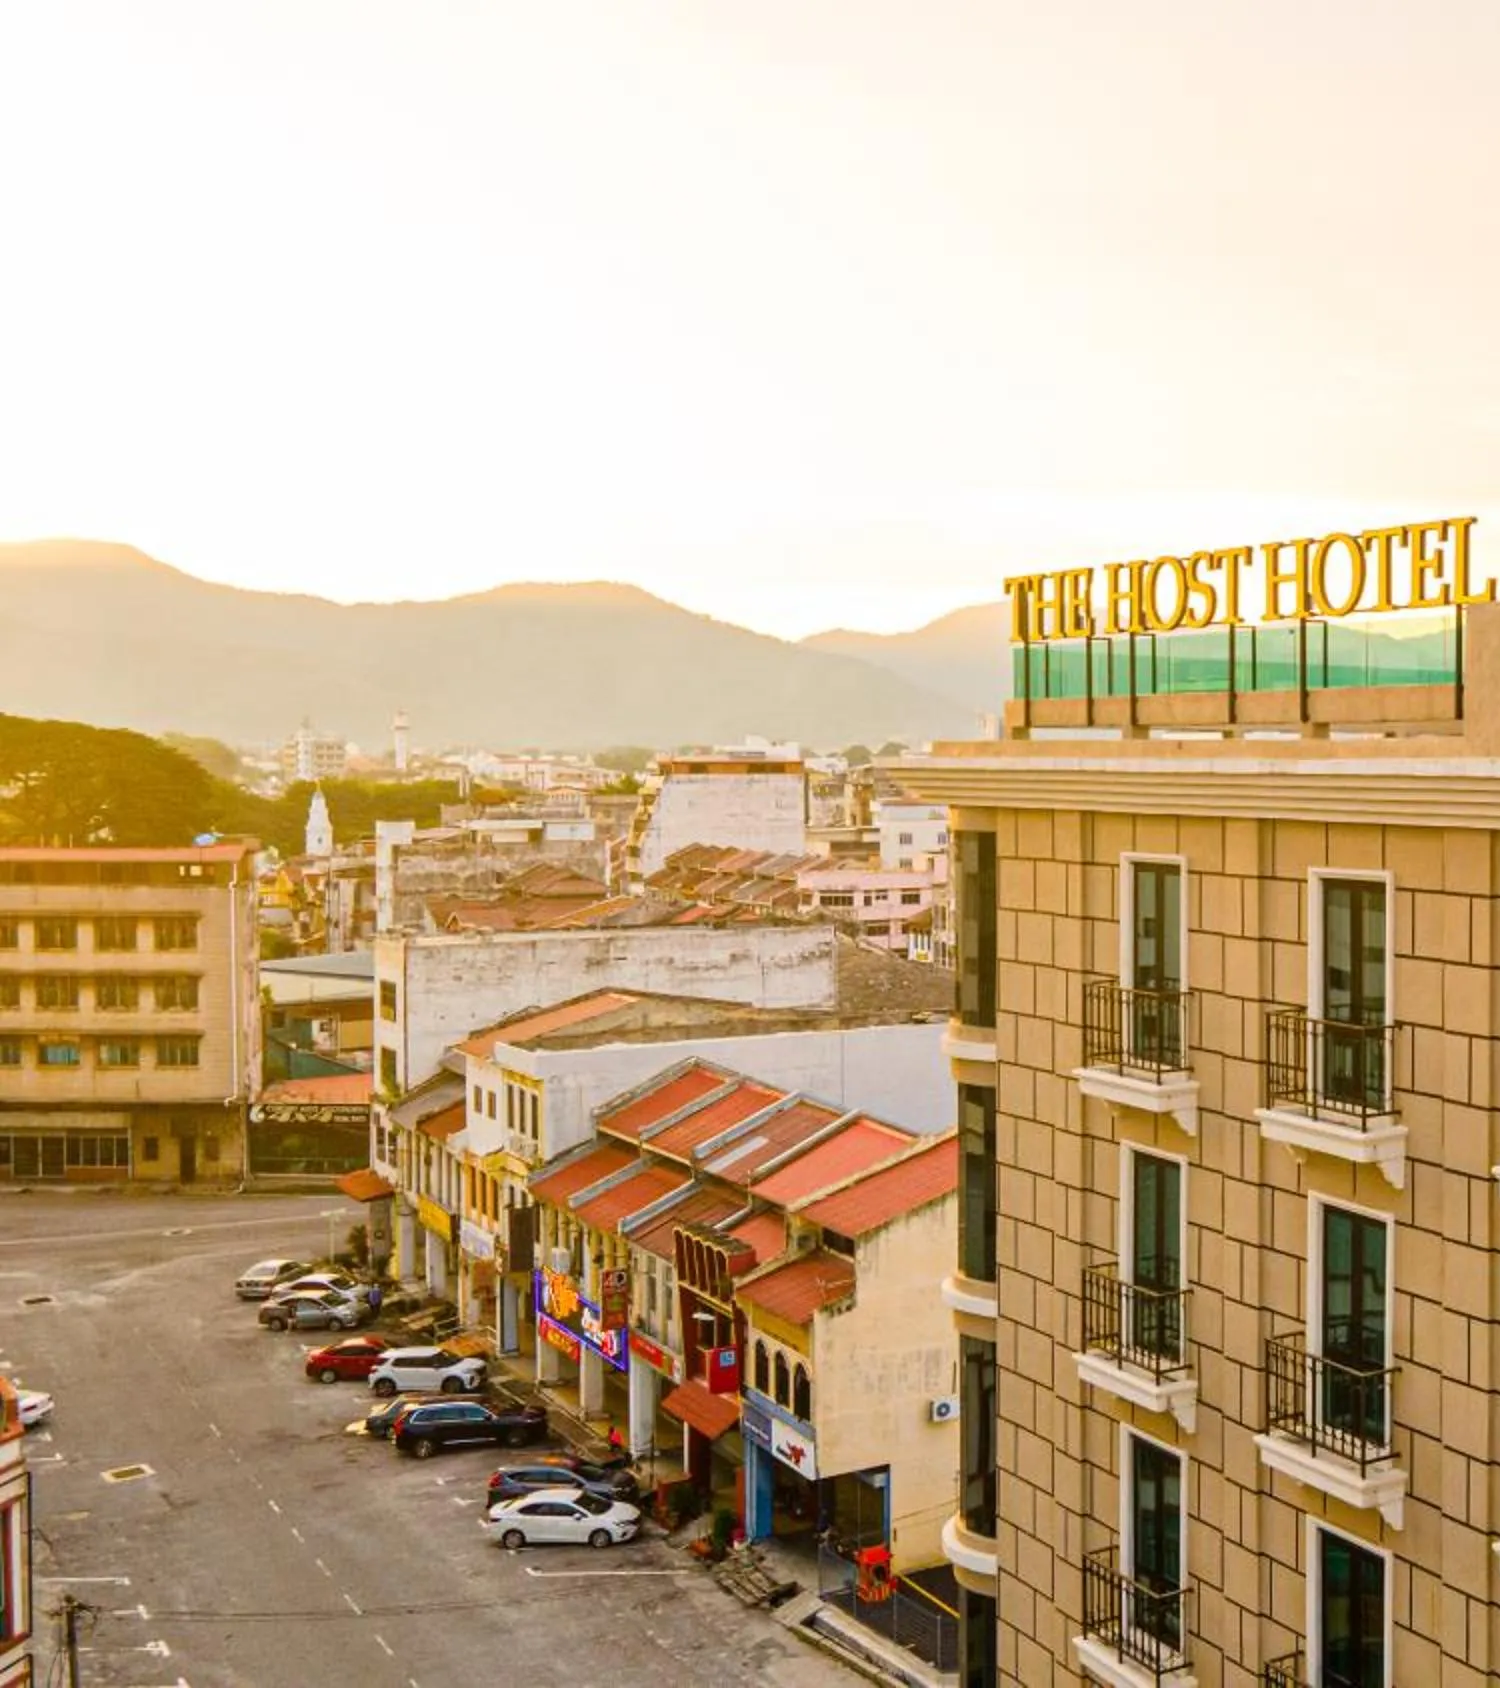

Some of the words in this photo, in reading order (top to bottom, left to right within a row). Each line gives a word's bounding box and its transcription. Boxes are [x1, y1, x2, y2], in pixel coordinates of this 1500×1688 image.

[1004, 568, 1095, 642] THE
[1103, 546, 1253, 634] HOST
[1260, 516, 1497, 621] HOTEL
